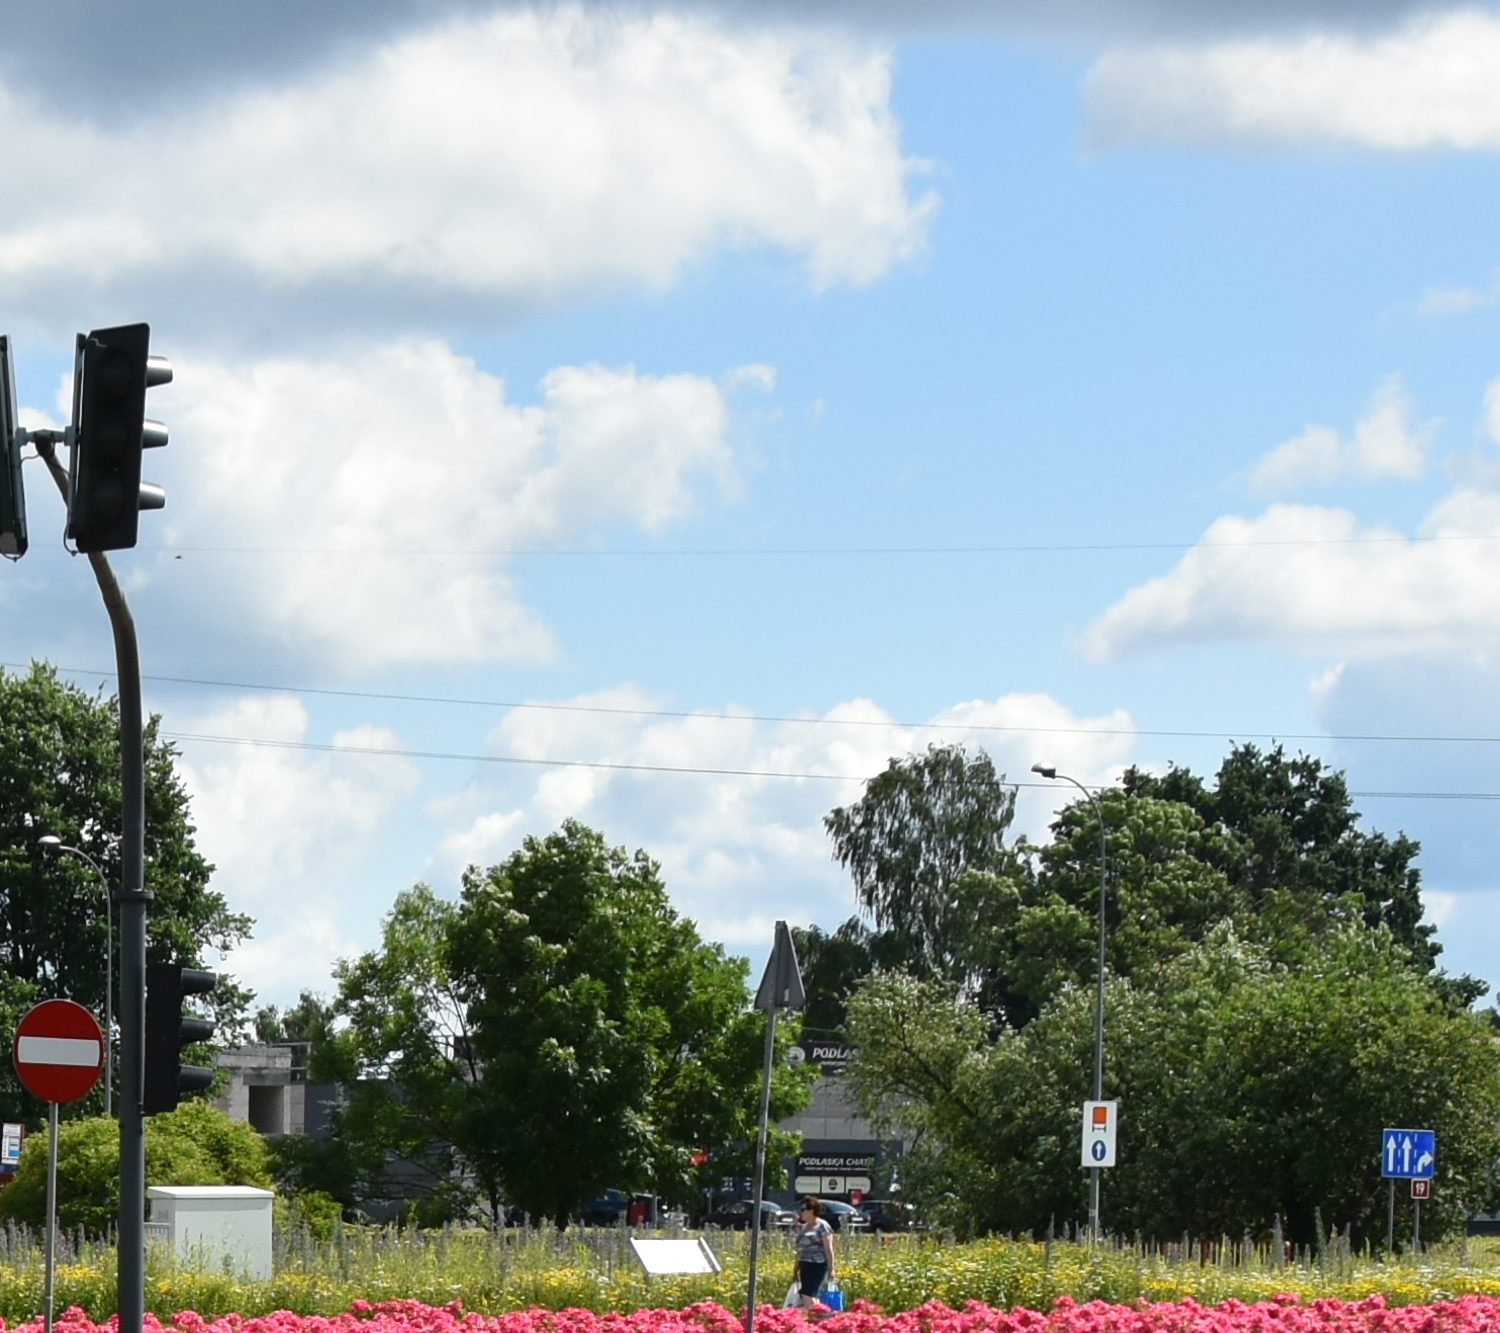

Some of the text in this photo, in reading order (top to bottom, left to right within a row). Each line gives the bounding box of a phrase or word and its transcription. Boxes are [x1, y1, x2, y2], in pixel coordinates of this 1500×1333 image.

[812, 1047, 859, 1059] PODLAS
[798, 1157, 844, 1166] PODLASKA
[1415, 1182, 1425, 1195] 19
